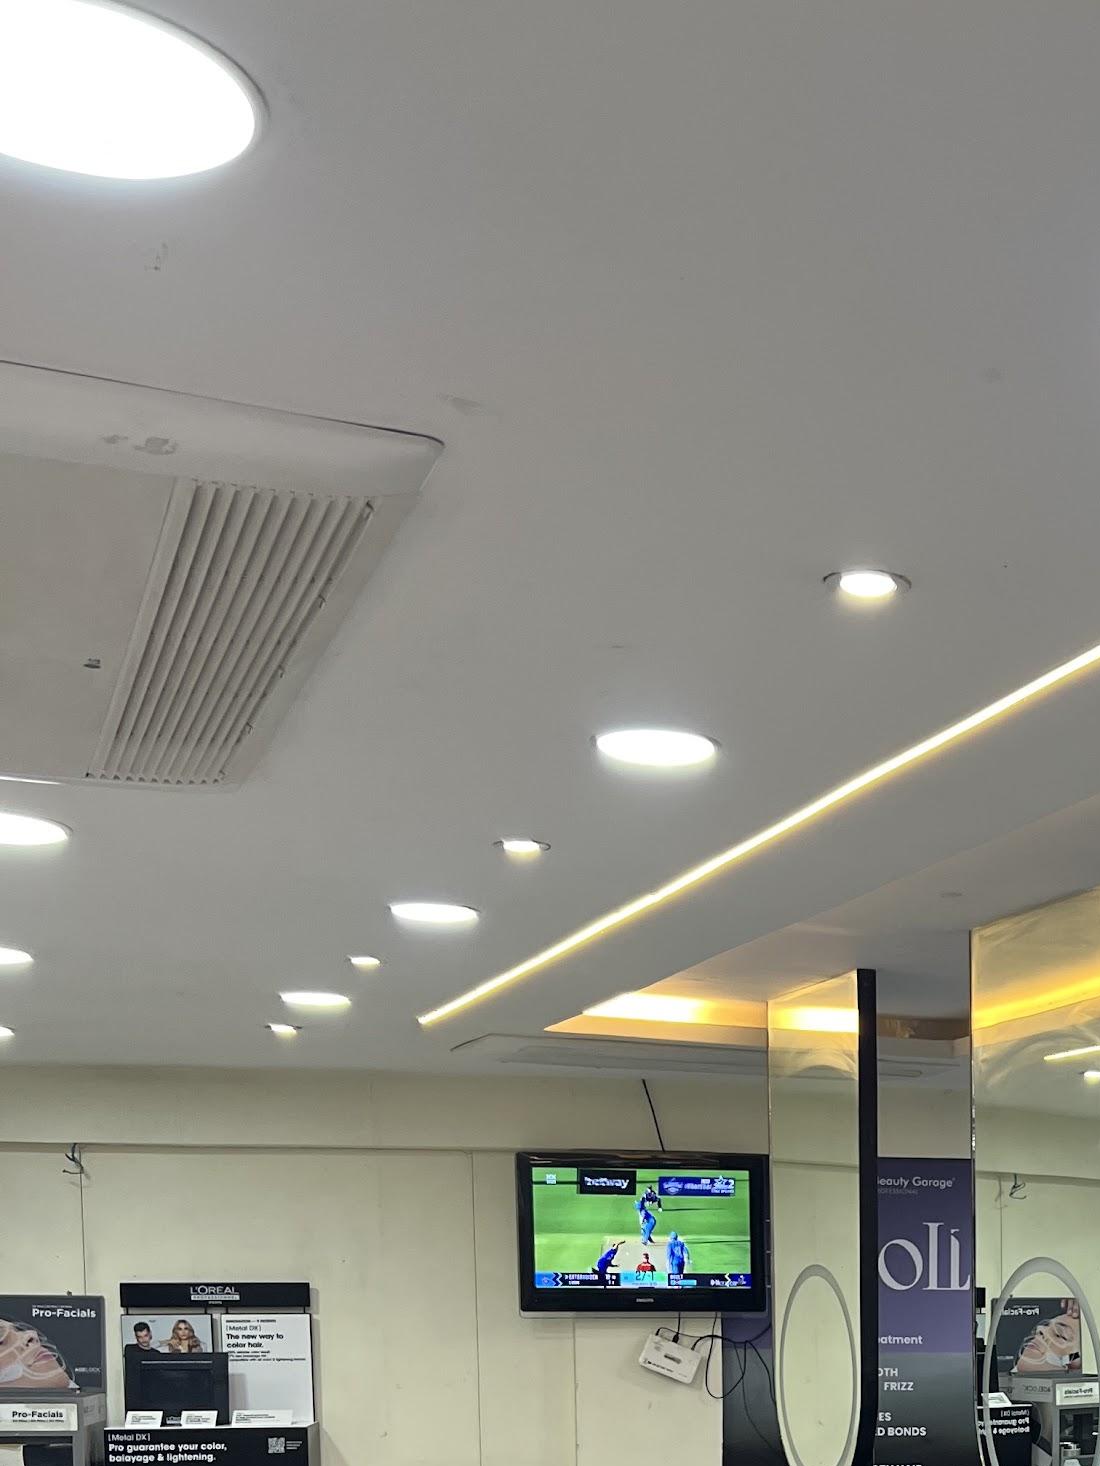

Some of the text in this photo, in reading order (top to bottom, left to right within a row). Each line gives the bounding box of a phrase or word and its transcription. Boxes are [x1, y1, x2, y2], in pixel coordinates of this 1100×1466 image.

[877, 1176, 953, 1190] eauty Garage
[32, 1308, 97, 1318] Pro-Facials
[878, 1335, 923, 1345] atment
[883, 1381, 914, 1391] FRIZZ
[12, 1410, 64, 1418] Pro-Facials
[887, 1426, 927, 1436] BONDS
[108, 1441, 227, 1454] Pro guarantee your color,
[109, 1452, 216, 1464] balayage & lightening.
